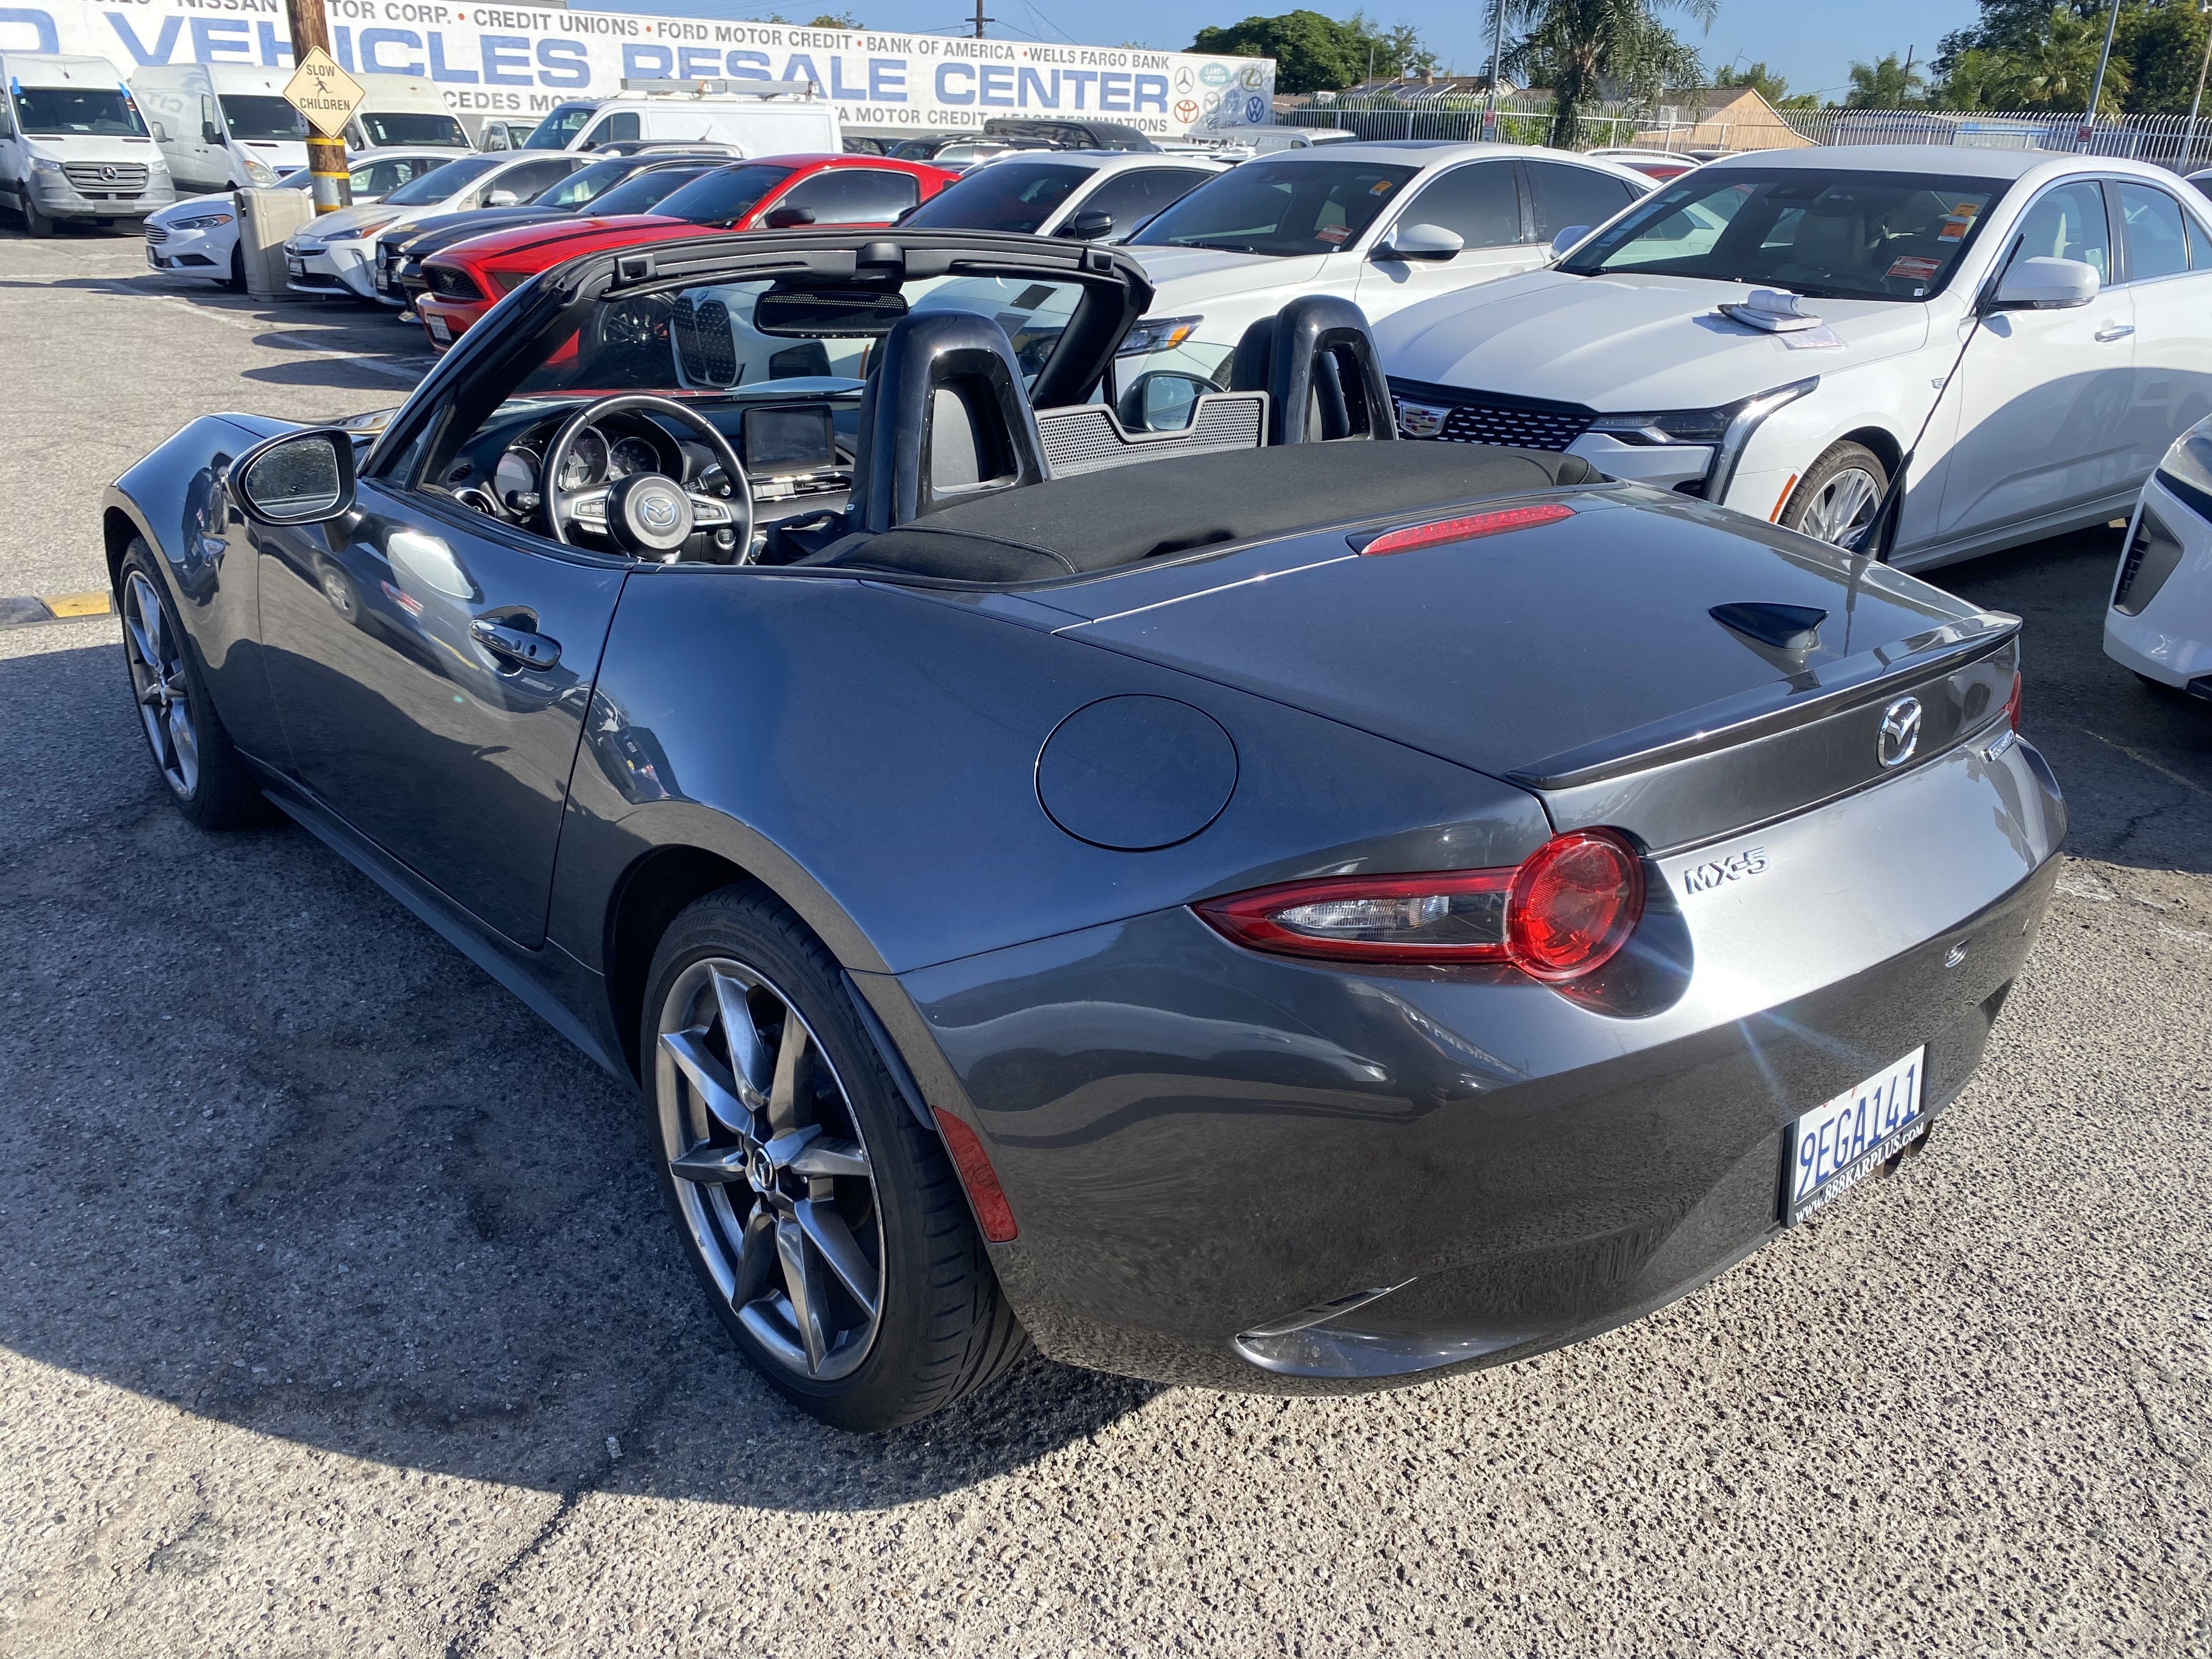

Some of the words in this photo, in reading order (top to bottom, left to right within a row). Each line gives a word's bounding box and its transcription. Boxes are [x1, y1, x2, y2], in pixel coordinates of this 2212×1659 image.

[328, 0, 376, 19] TOR
[385, 2, 451, 25] CORP.
[473, 9, 551, 30] CREDIT
[560, 14, 639, 36] UNIONS
[658, 21, 708, 40] FORD
[715, 26, 782, 46] MOTOR
[789, 31, 852, 50] CREDIT
[867, 36, 913, 54] BANK
[919, 40, 939, 55] OF
[944, 42, 1015, 60] AMERICA
[1029, 47, 1076, 64] WELLS
[1081, 50, 1127, 67] FARGO
[1132, 54, 1170, 70] BANK
[102, 11, 591, 89] VEHICLES
[622, 42, 908, 103] RESALE
[935, 62, 1169, 114] CENTER
[306, 64, 335, 76] SLOW
[299, 98, 351, 111] CHILDREN
[442, 91, 520, 111] CEDES
[856, 107, 921, 124] MOTOR
[928, 109, 988, 126] CREDIT
[1057, 115, 1167, 132] NATIONS
[1206, 117, 1246, 131] Cadill
[1684, 846, 1771, 895] MX-5
[1796, 1062, 1916, 1201] 9EGA141
